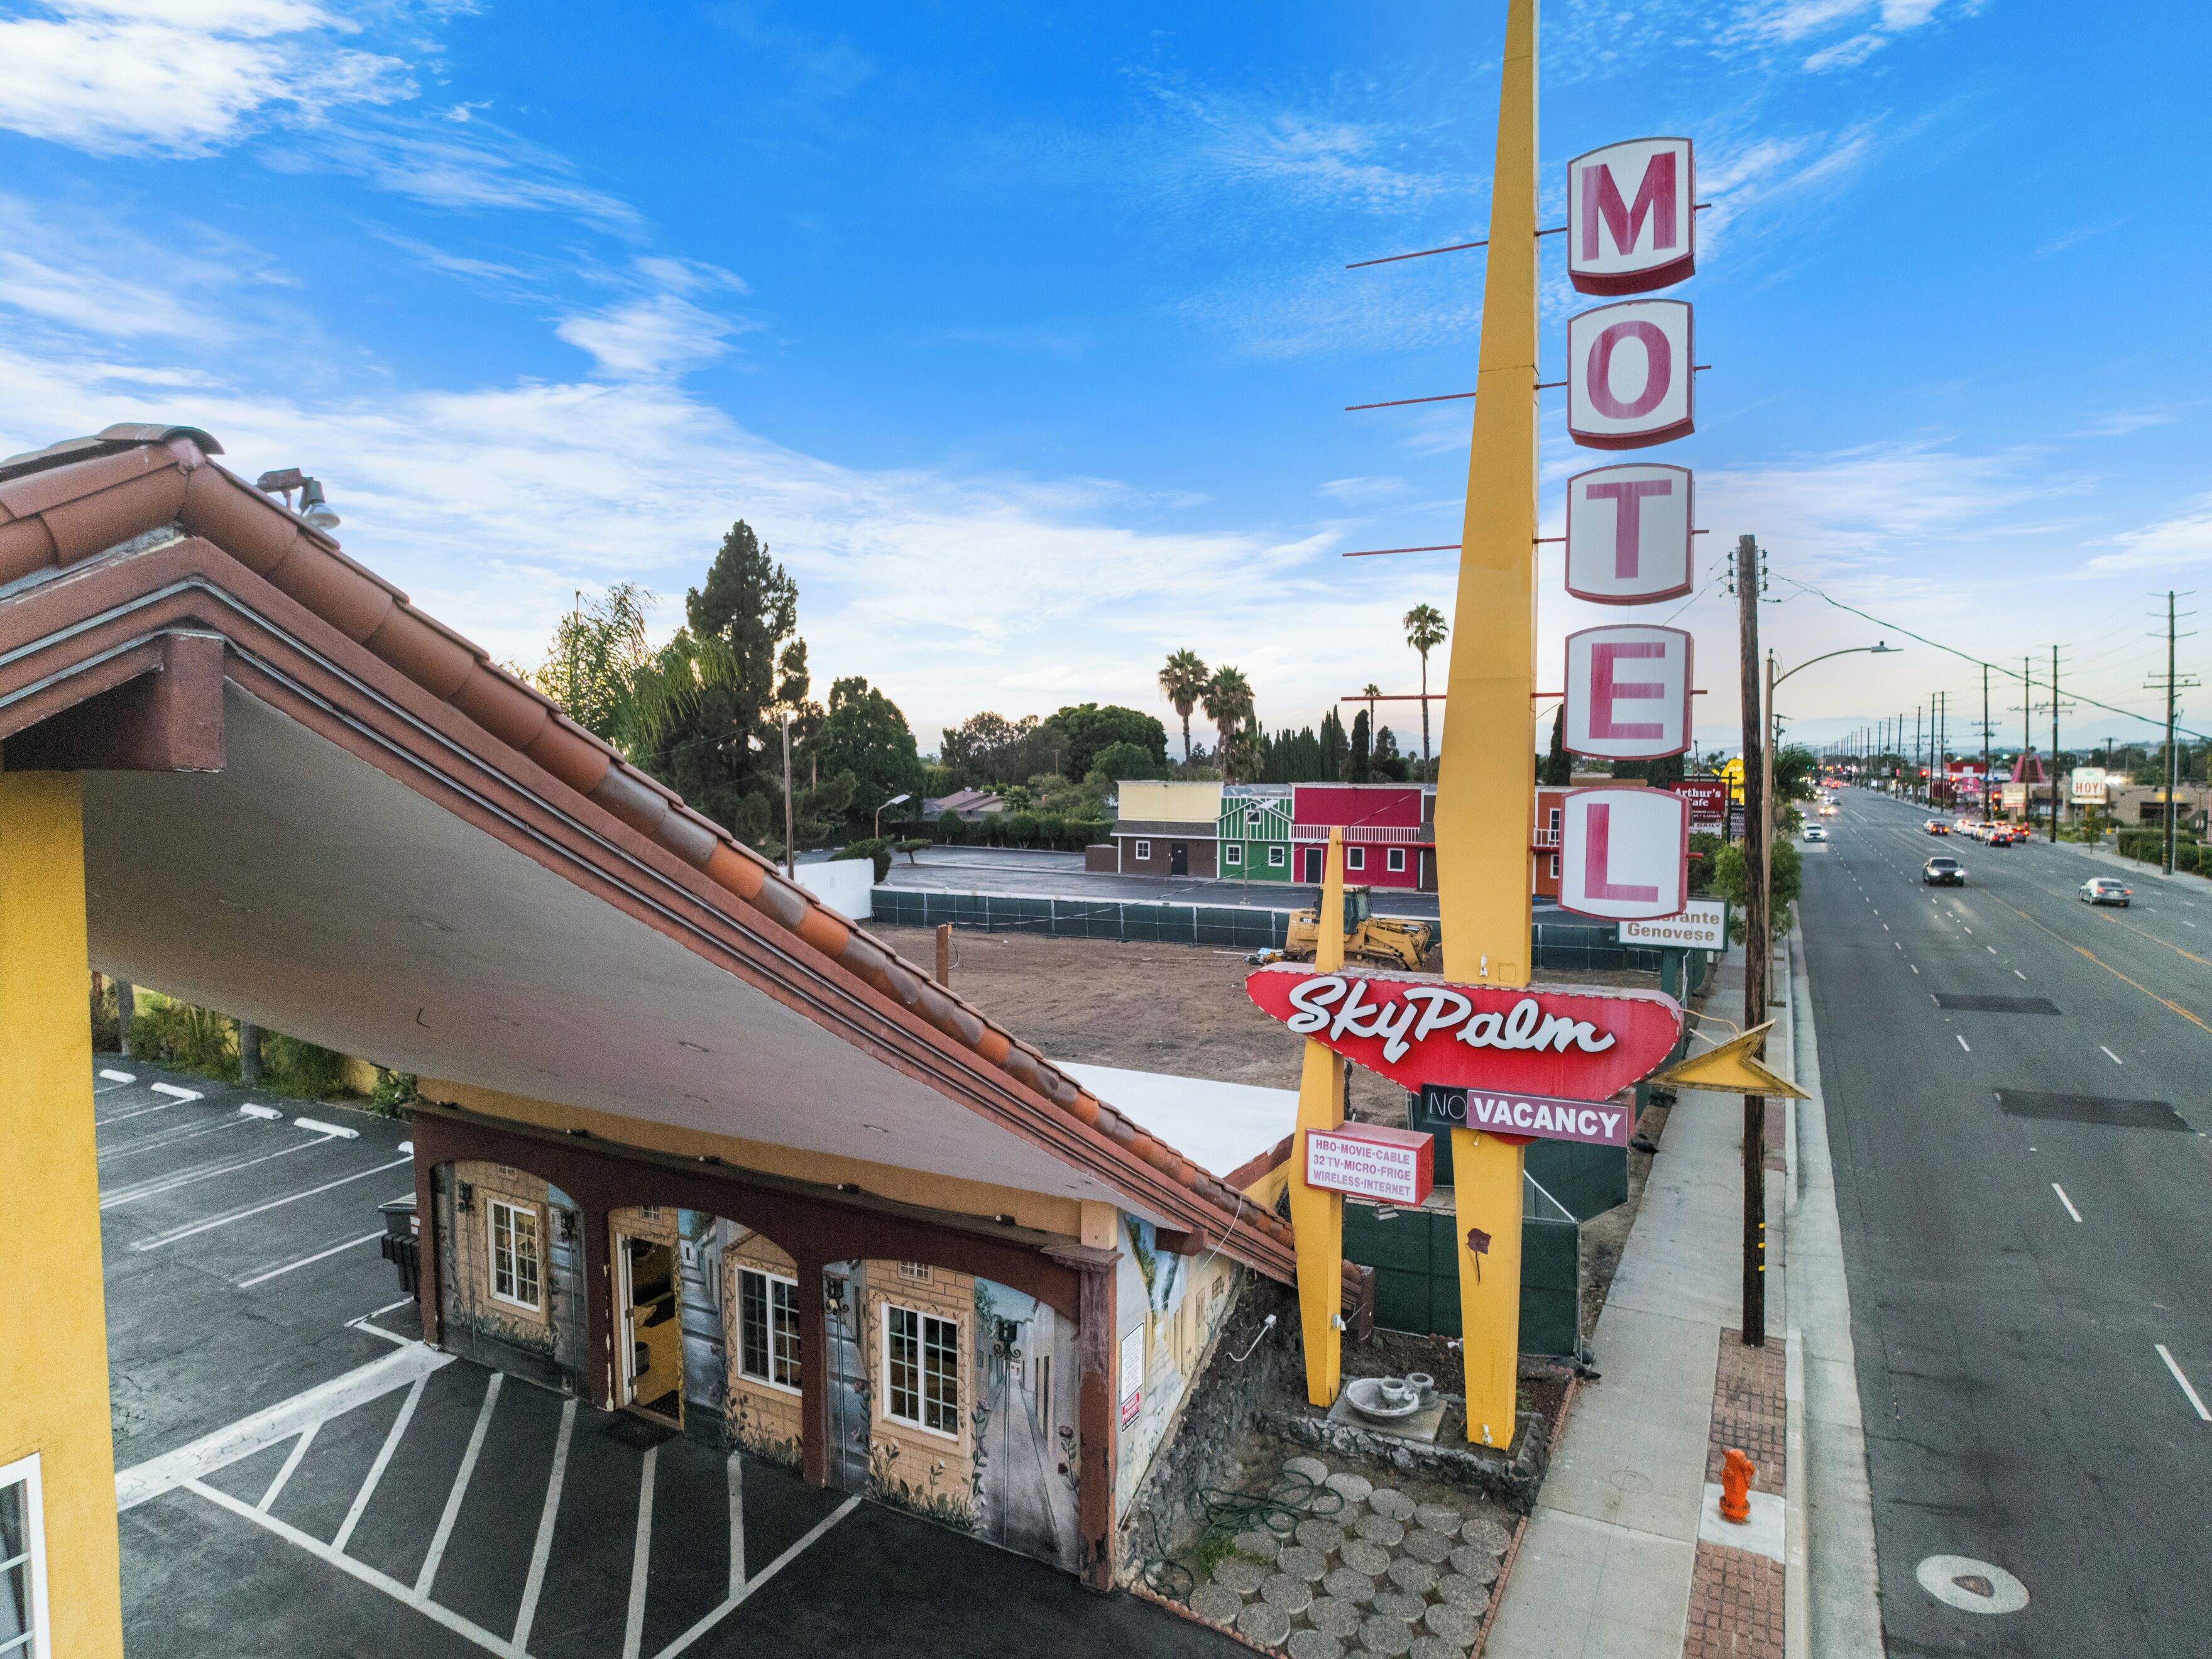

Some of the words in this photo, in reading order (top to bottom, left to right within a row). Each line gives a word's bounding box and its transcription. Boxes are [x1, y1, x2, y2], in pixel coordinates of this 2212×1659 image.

[1582, 151, 1677, 902] MOTEL
[1675, 788, 1721, 798] Arthur's
[1690, 798, 1709, 806] afe
[1628, 923, 1715, 941] Genovese
[1430, 1092, 1467, 1119] NO
[1473, 1097, 1621, 1138] VACANCY
